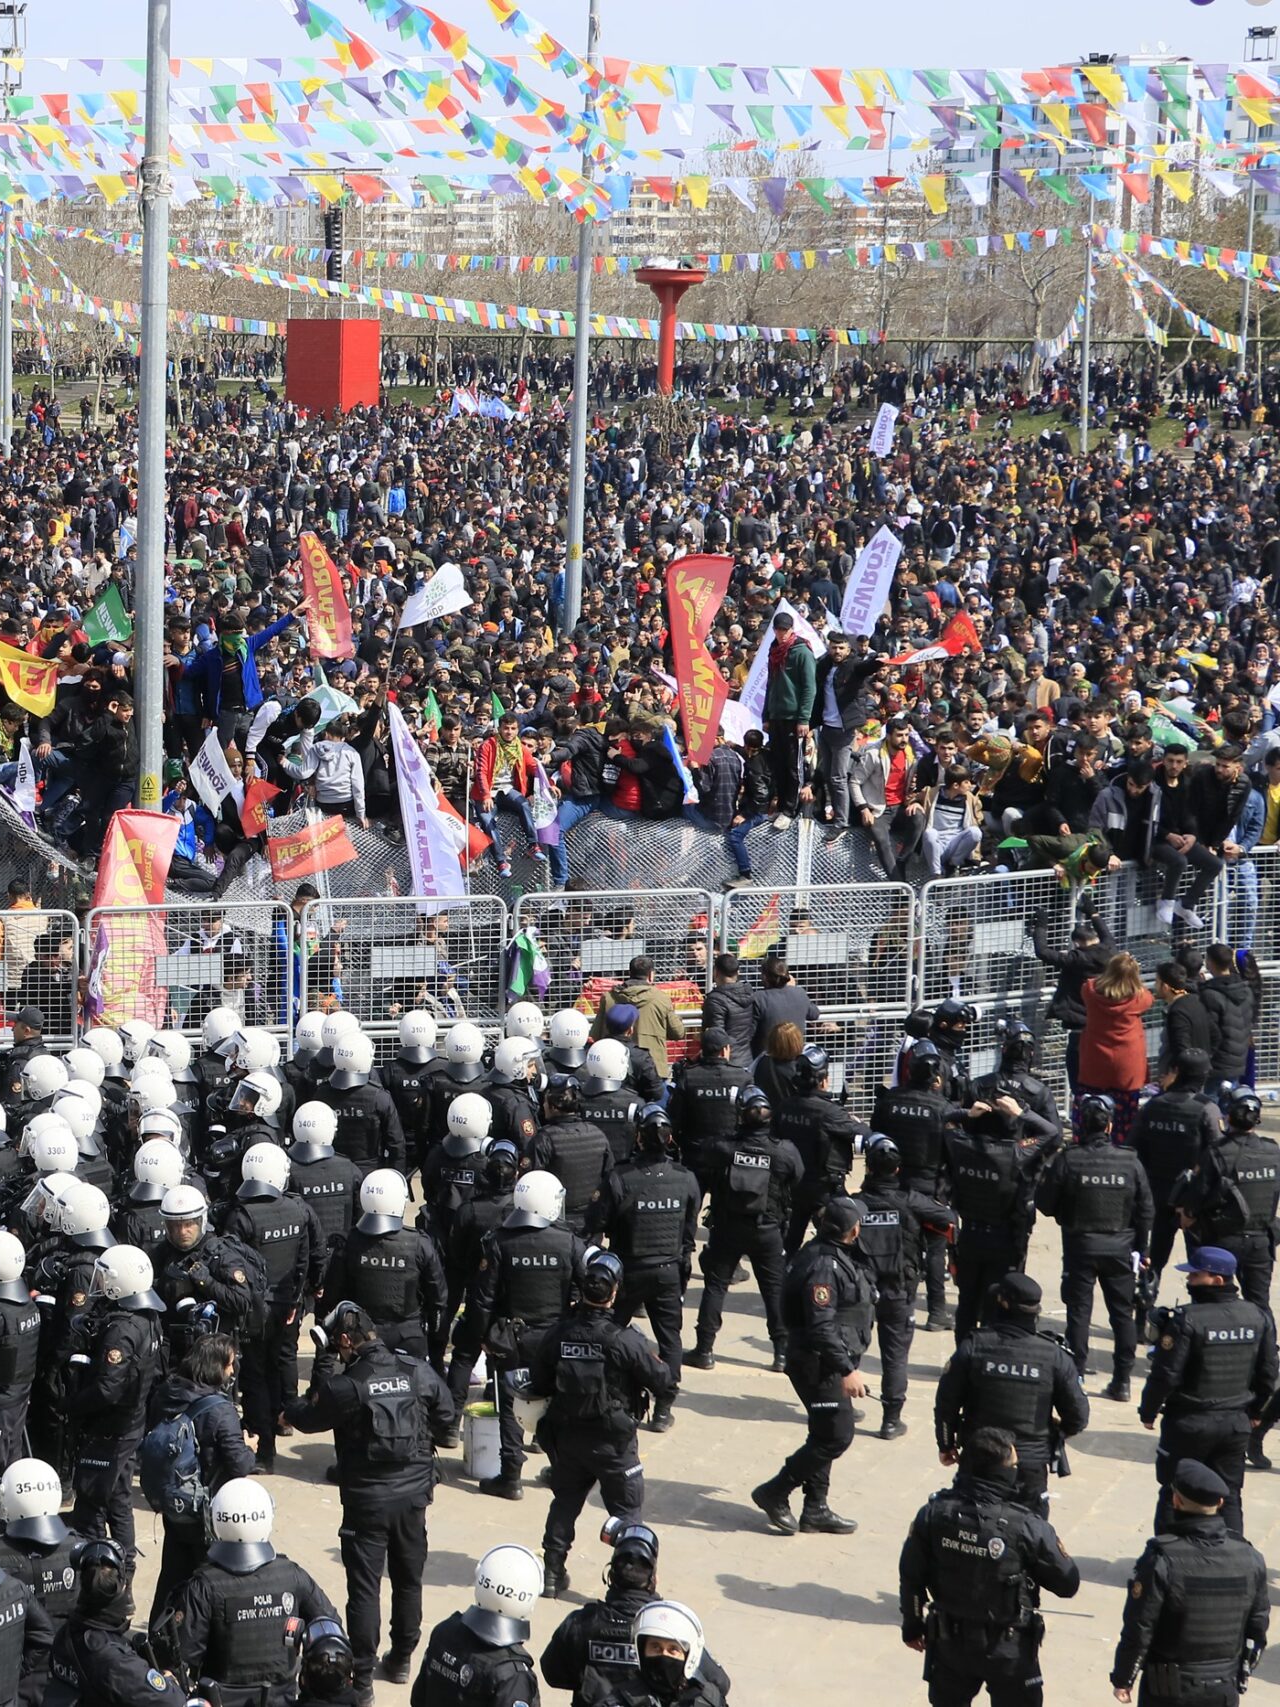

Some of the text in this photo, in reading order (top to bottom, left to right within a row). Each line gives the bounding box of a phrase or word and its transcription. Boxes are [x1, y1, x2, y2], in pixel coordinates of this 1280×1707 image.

[427, 604, 445, 618] HDP
[19, 763, 27, 784] HDP
[697, 1088, 733, 1098] POLİ
[335, 1107, 364, 1118] OLİS
[585, 1110, 624, 1119] POLİS
[892, 1105, 930, 1118] POLİS
[452, 1115, 468, 1125] 3102
[1149, 1121, 1186, 1133] POLİS
[736, 1153, 770, 1167] POLİS
[960, 1166, 999, 1181] POLİS
[1238, 1168, 1276, 1180] POLİS
[1082, 1175, 1125, 1186] POLİS
[303, 1182, 345, 1194] POLİS
[638, 1199, 680, 1210] POLİS
[862, 1212, 899, 1224] POLİS
[264, 1225, 300, 1240] POLİS
[360, 1256, 406, 1267] POLİS
[512, 1256, 558, 1267] POLİS
[1209, 1326, 1255, 1341] POLİS
[986, 1361, 1040, 1378] POLİS
[369, 1378, 410, 1395] POLİS
[216, 1510, 266, 1525] 35-01-04
[961, 1543, 988, 1557] KUVVET
[478, 1574, 534, 1603] 35-02-07
[258, 1606, 283, 1617] KUVVET
